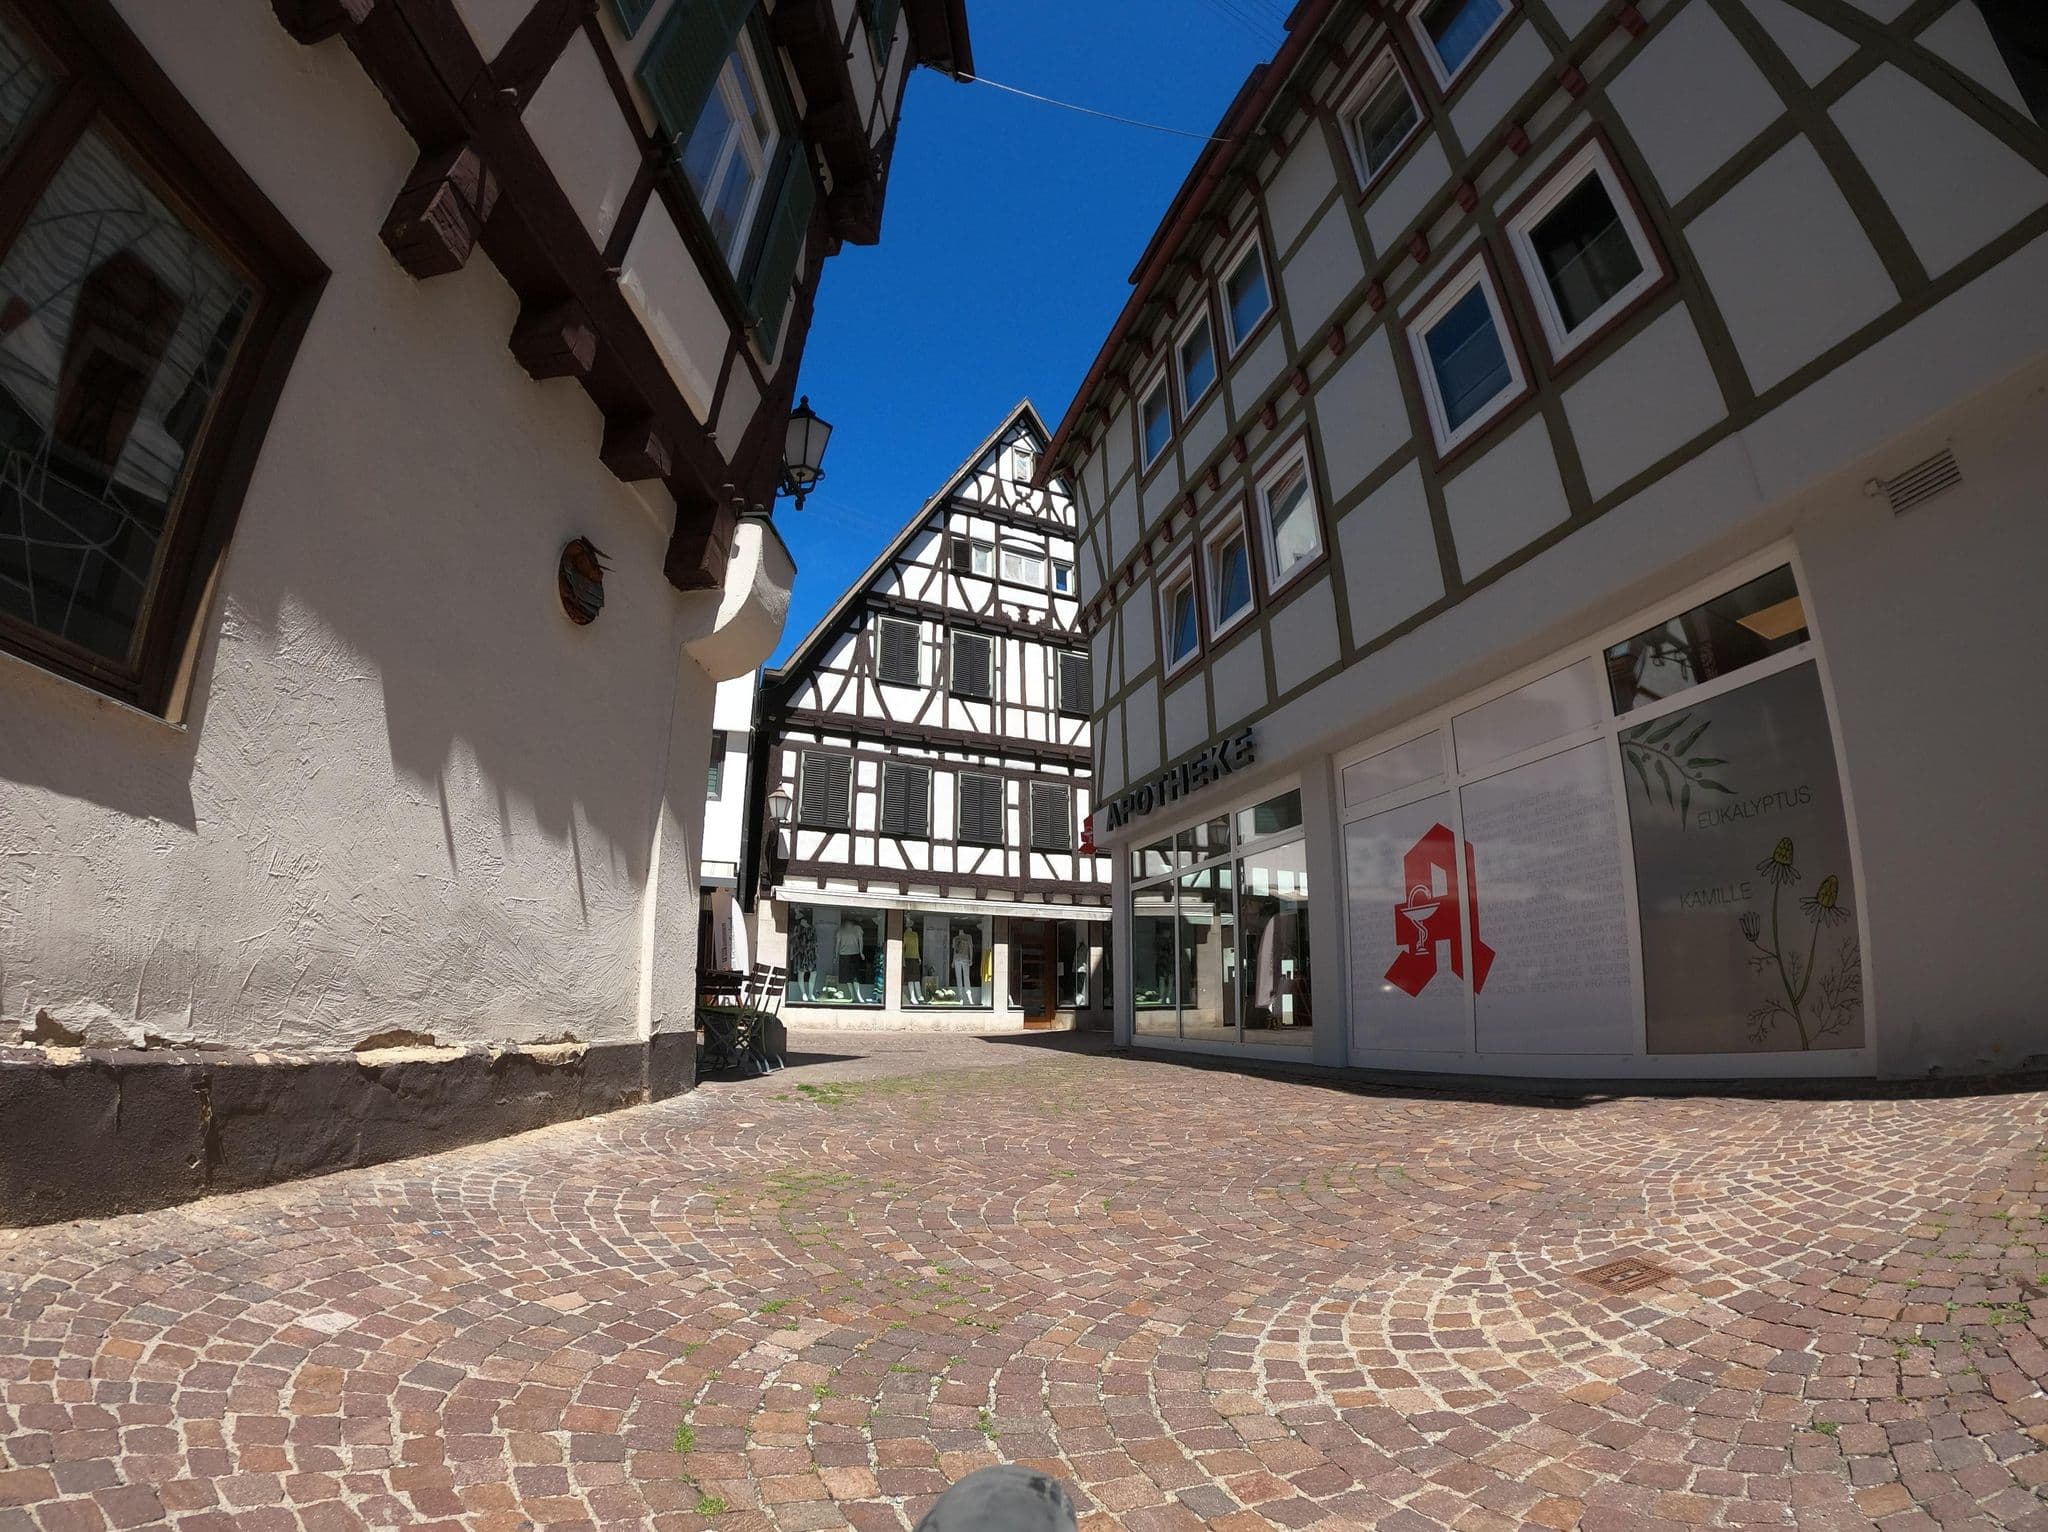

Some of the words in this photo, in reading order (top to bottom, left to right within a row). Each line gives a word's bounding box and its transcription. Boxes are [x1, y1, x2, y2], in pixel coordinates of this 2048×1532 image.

[1106, 727, 1258, 832] APOTHEKE
[1697, 785, 1812, 830] EUKALYPTUS
[1680, 881, 1753, 909] KAMILLE
